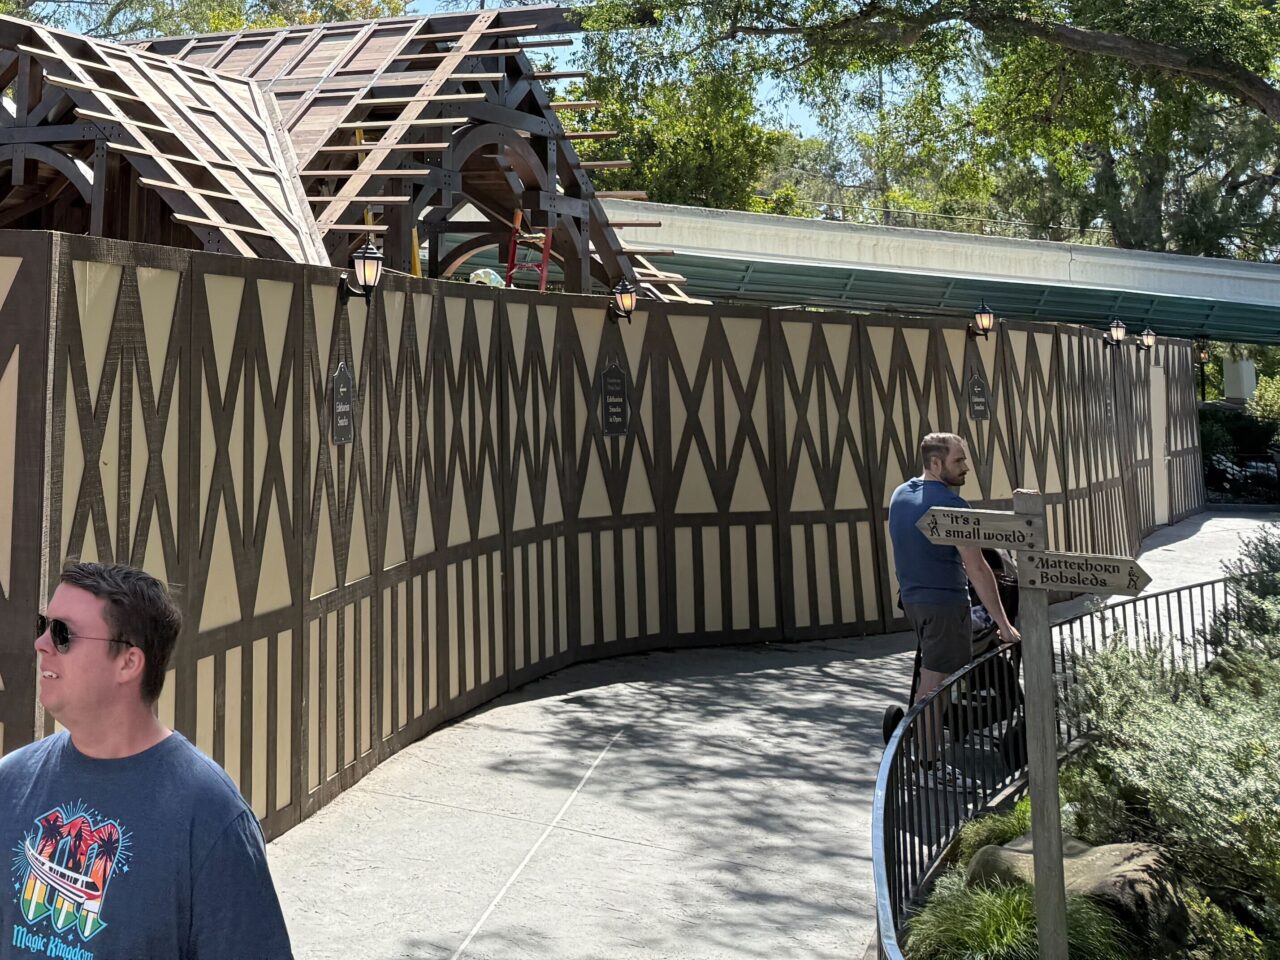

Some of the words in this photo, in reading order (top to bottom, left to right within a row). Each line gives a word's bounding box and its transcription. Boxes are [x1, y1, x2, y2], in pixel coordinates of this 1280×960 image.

[973, 517, 981, 527] a
[944, 527, 981, 541] small
[1035, 556, 1121, 574] Matterhorn
[1039, 571, 1108, 588] Bobsleds
[13, 925, 47, 952] Magic
[46, 935, 94, 960] Kingdom
